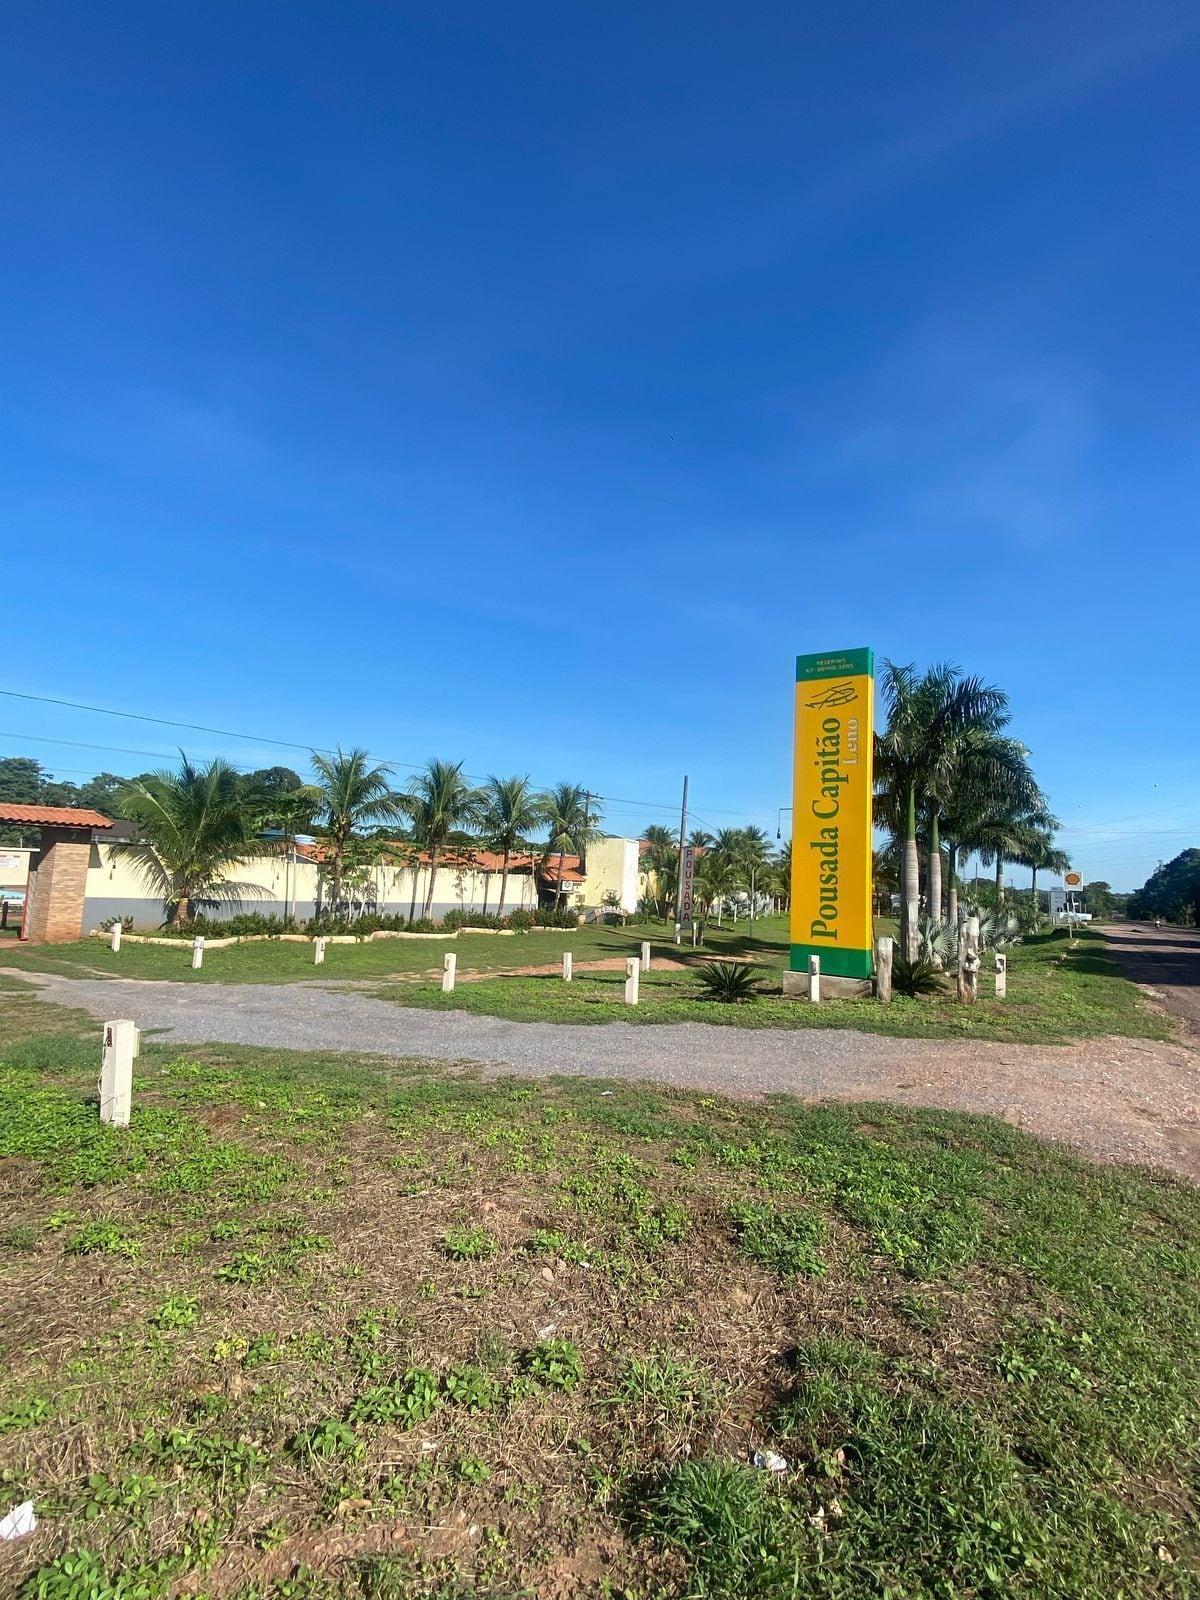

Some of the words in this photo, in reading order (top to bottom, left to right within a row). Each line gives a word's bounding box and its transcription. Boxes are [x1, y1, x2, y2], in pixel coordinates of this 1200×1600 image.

[811, 717, 849, 820] Capitão
[843, 717, 859, 765] Leno
[683, 850, 693, 921] POUSADA
[810, 826, 839, 940] Pousada
